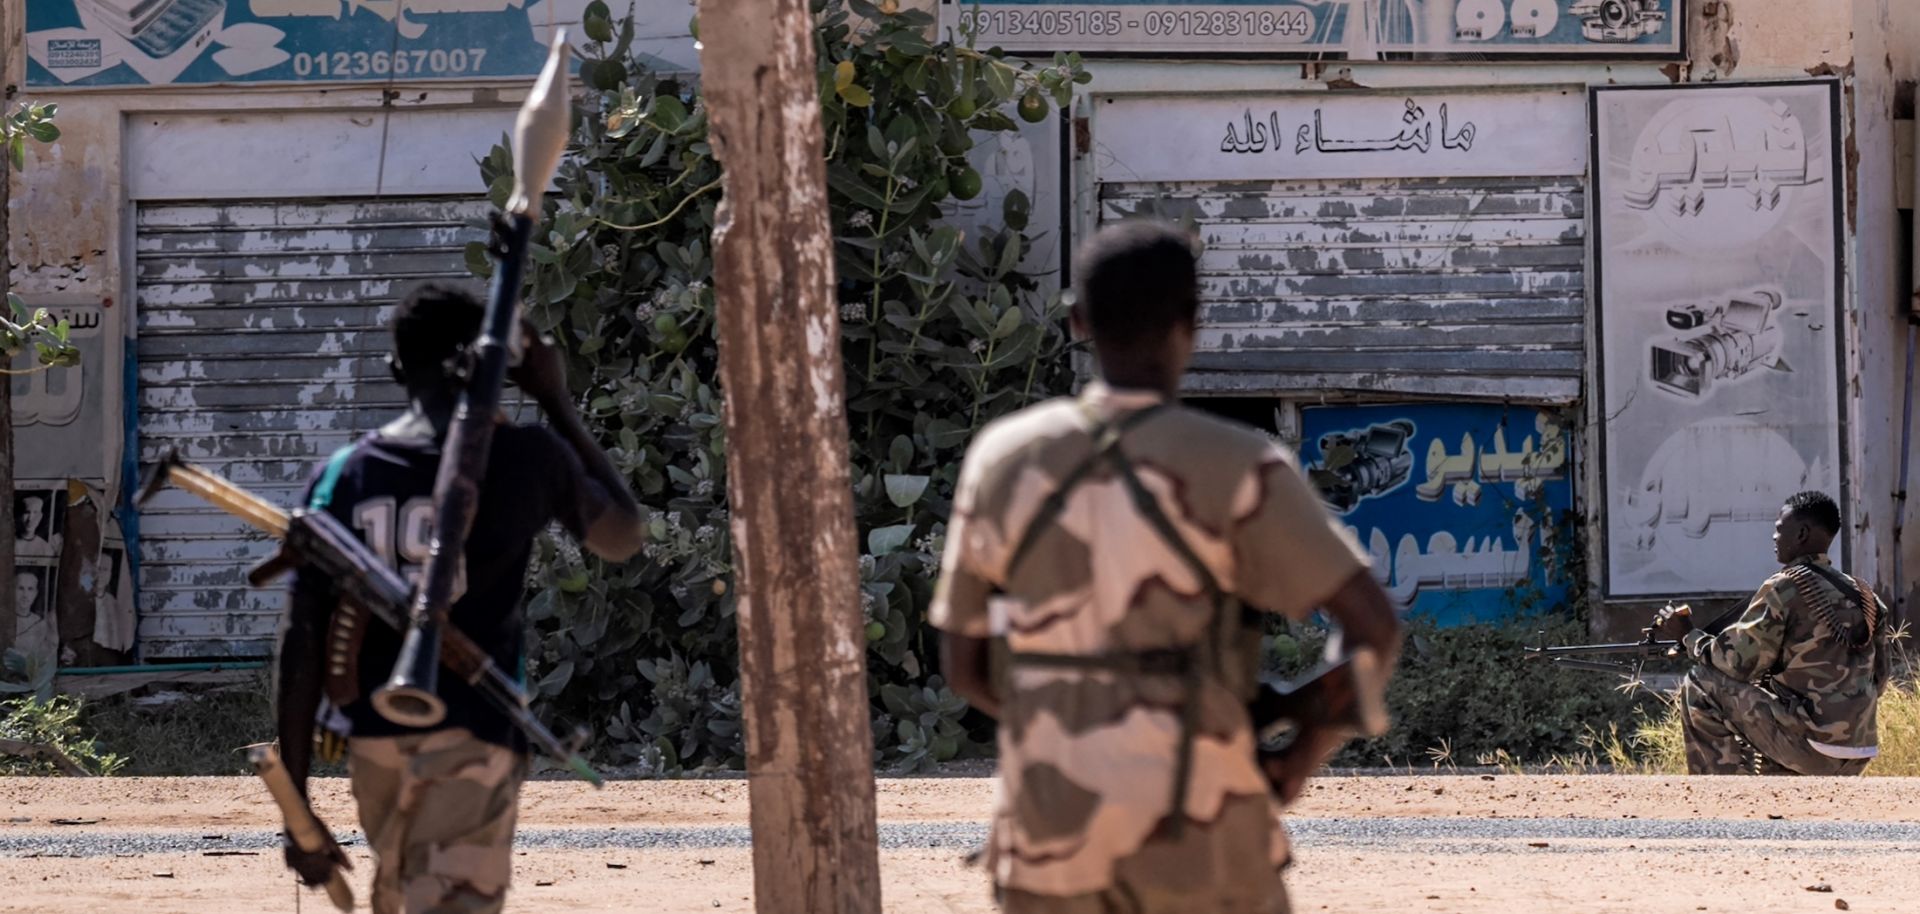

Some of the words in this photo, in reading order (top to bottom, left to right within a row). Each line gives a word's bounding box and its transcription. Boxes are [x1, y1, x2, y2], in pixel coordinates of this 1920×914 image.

[960, 10, 1122, 35] 0913405185
[1145, 11, 1308, 35] 0912831844
[293, 48, 488, 76] 0123667007
[1220, 107, 1281, 154] الله
[1623, 98, 1808, 217] فيديو
